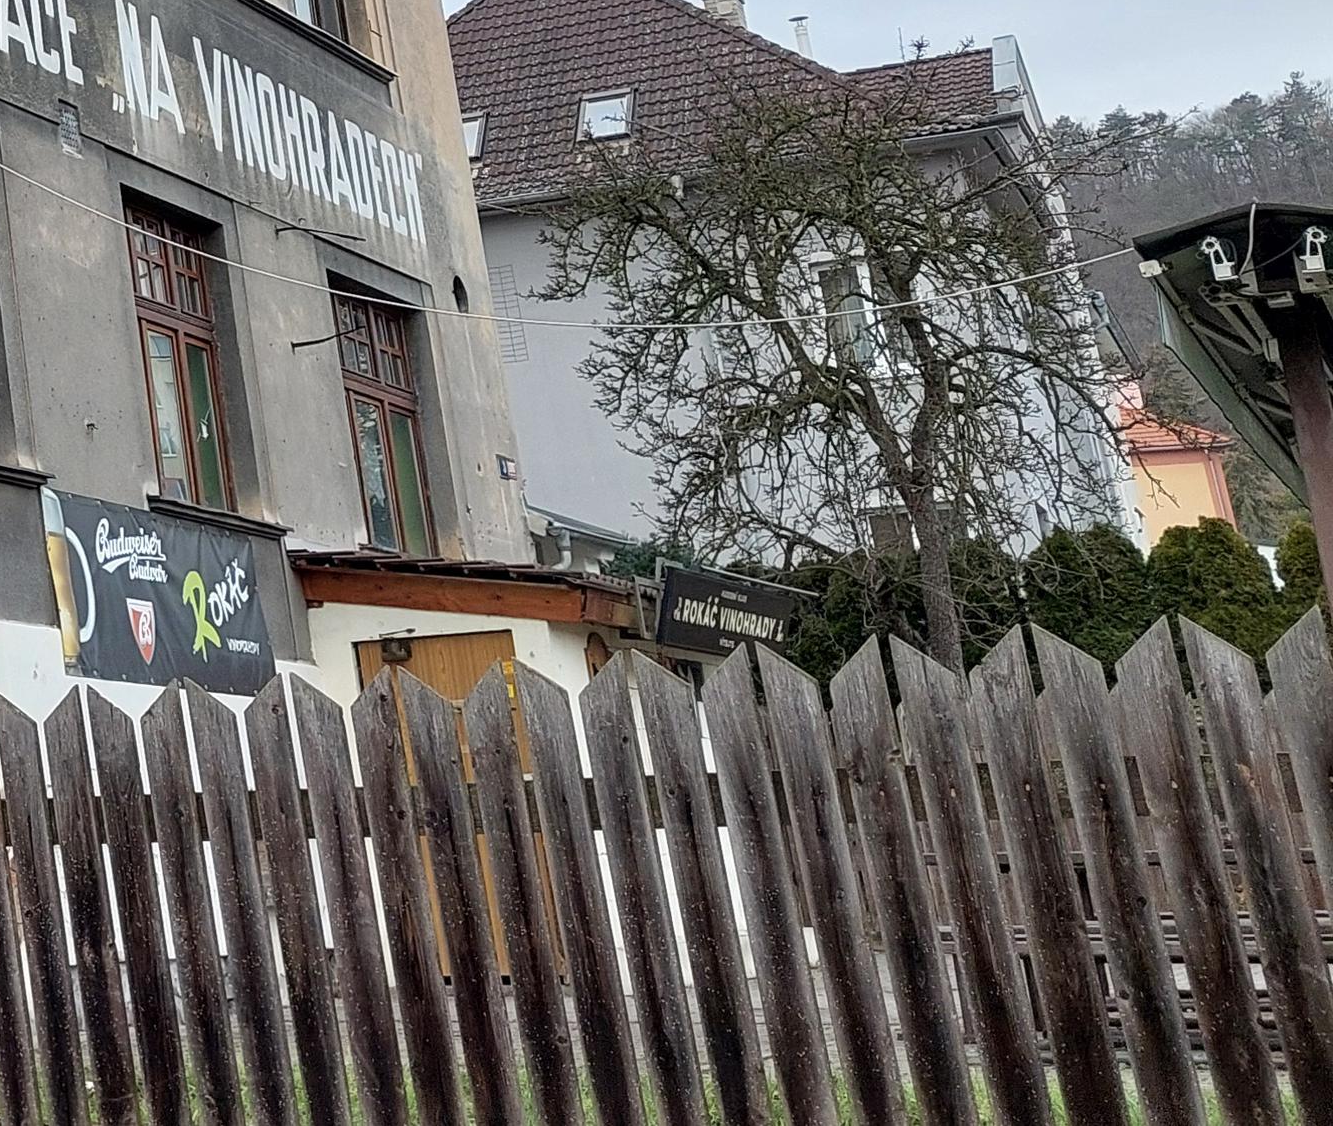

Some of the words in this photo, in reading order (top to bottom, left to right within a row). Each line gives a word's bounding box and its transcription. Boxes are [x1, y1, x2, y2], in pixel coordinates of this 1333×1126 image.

[95, 518, 166, 566] Budweiser
[129, 553, 169, 584] Budvar
[683, 595, 719, 628] ROKÁČ
[720, 606, 777, 640] VINOHRADY
